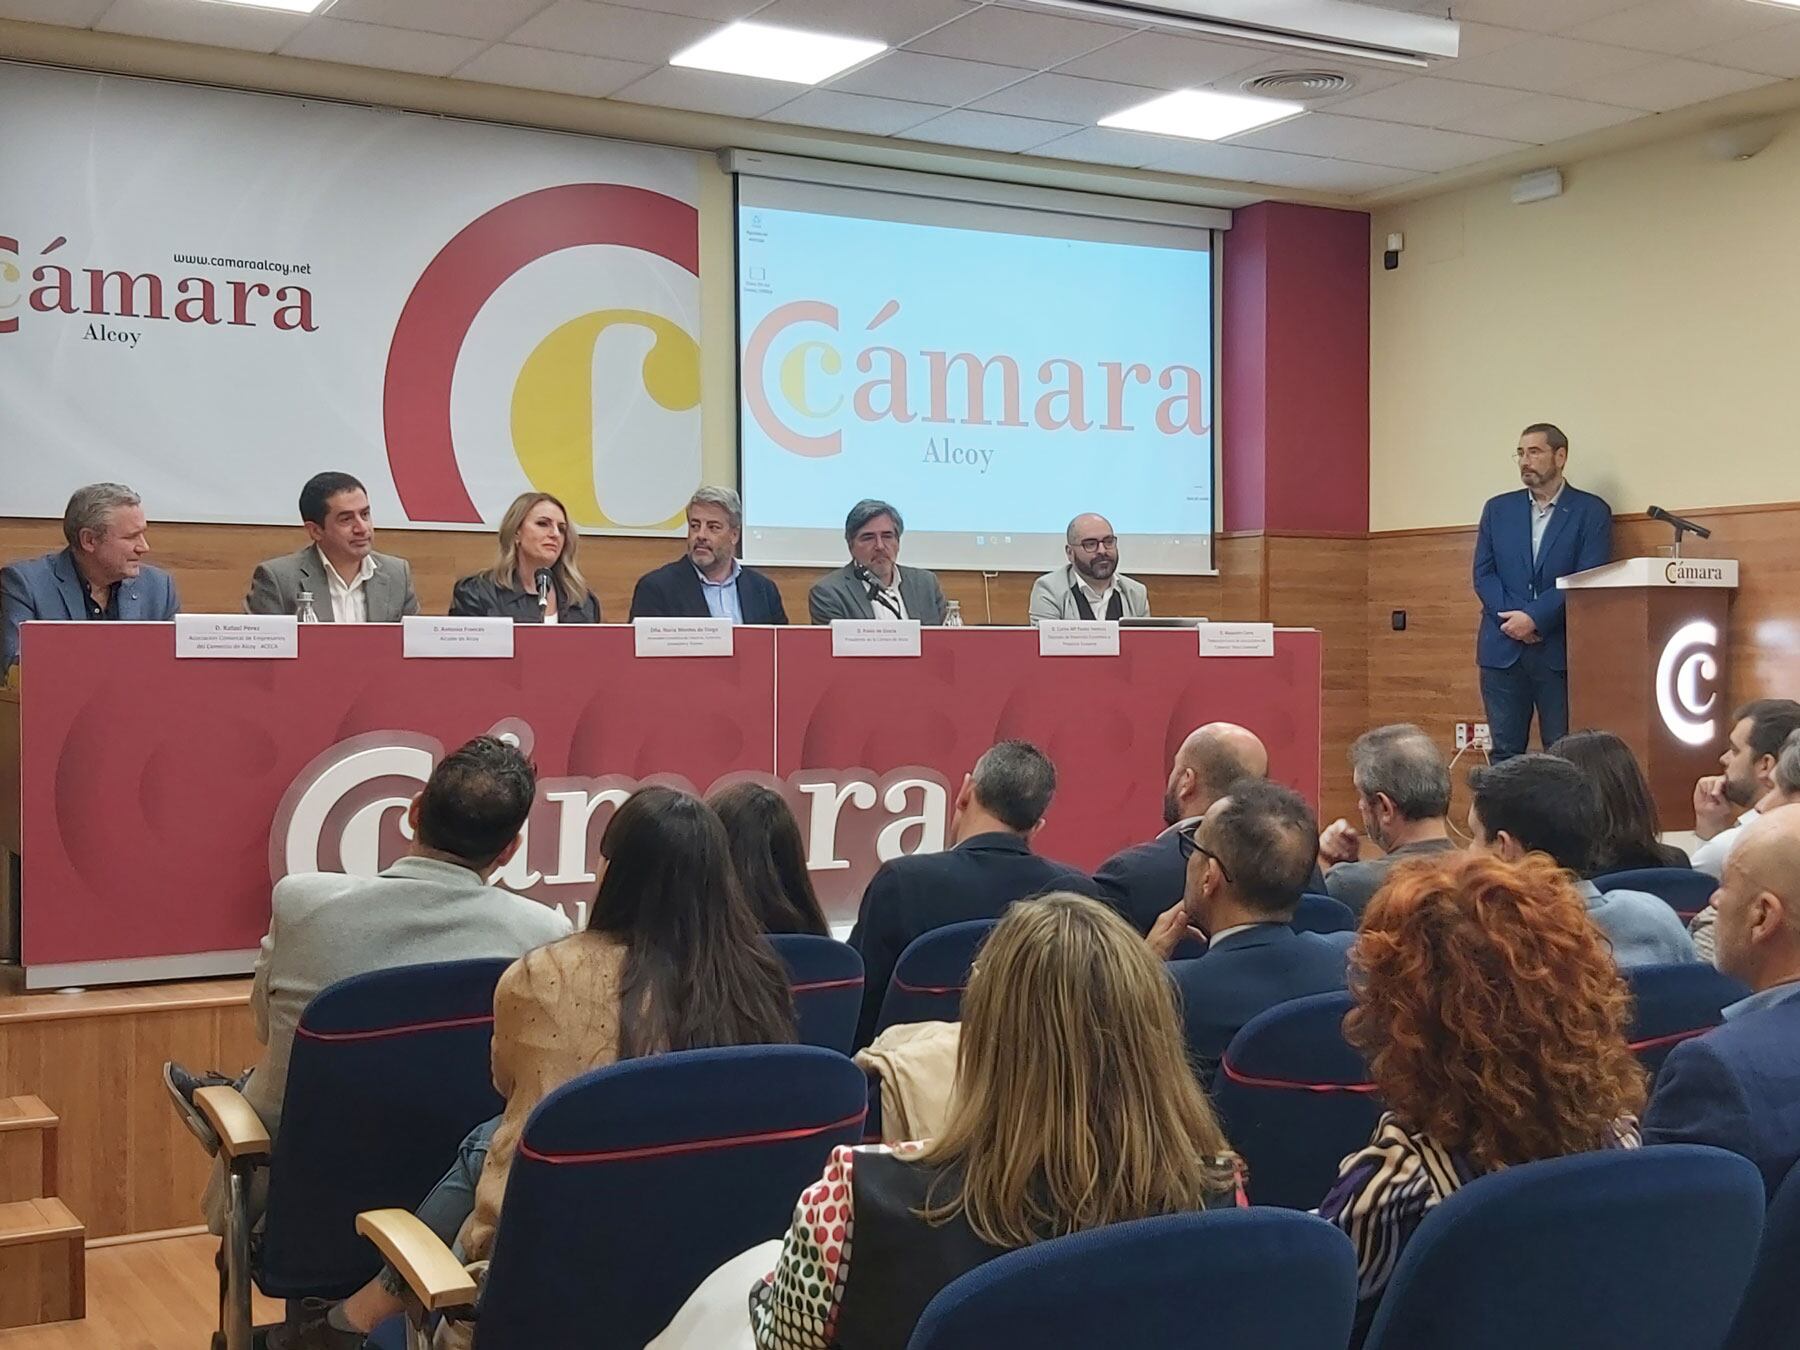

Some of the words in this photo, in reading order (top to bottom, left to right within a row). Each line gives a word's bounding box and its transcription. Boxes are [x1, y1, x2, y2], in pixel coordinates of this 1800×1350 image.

[173, 253, 312, 275] www.camaraalcoy.net
[0, 236, 319, 333] ámara
[82, 322, 142, 348] Alcoy
[743, 299, 1211, 458] Cámara
[922, 437, 995, 473] Alcoy
[1665, 561, 1722, 584] Cámara
